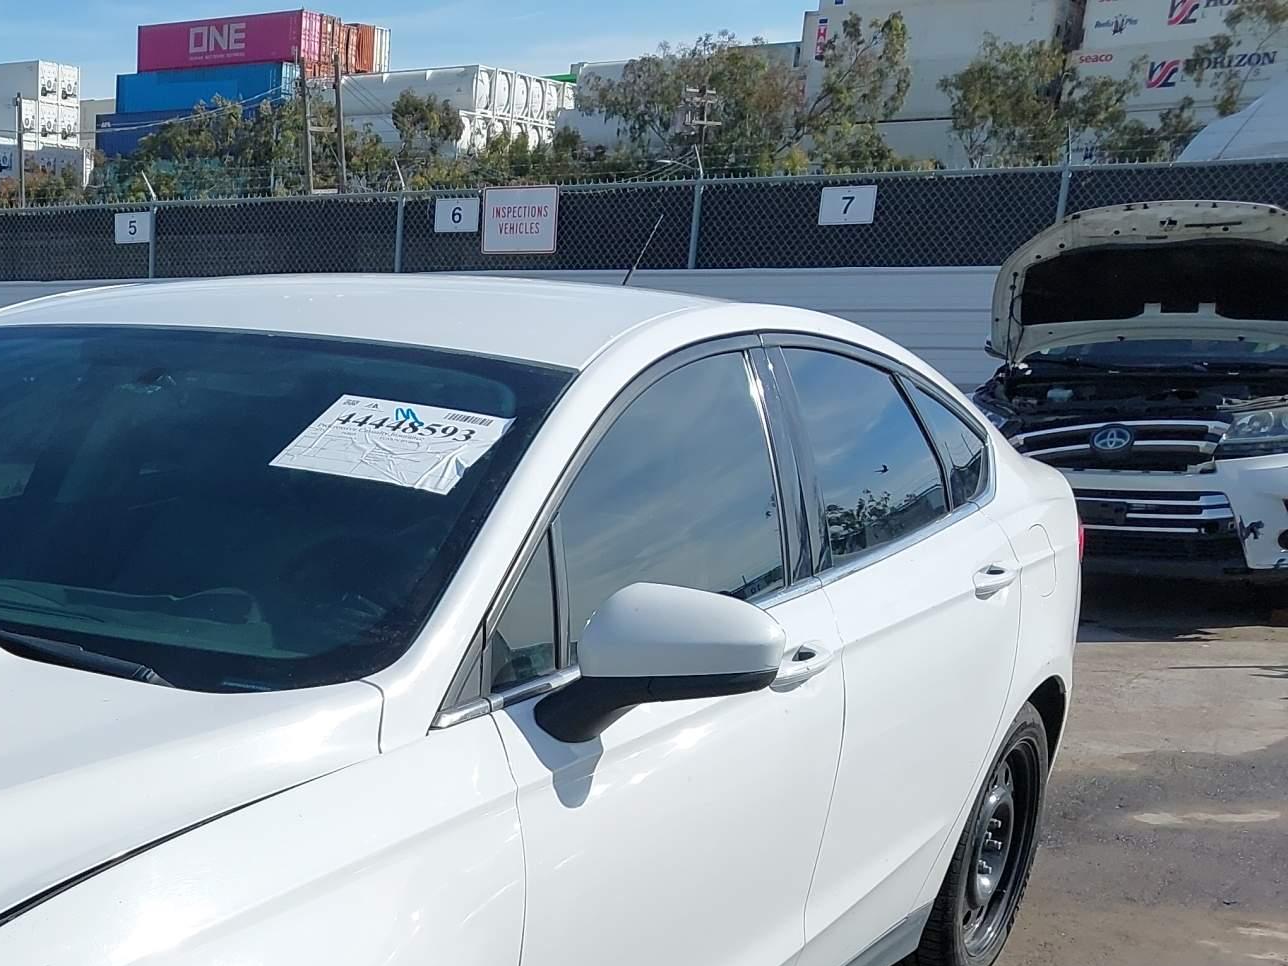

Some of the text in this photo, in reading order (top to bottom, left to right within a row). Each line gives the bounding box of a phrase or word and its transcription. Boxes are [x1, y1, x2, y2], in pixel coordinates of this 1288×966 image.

[189, 23, 246, 53] ONE
[1079, 53, 1113, 64] seaco
[492, 205, 549, 219] INSPECTIONS
[841, 196, 856, 215] 7
[451, 206, 463, 224] 6
[128, 220, 138, 236] 5
[498, 222, 540, 235] VEHICLES
[336, 412, 476, 442] 44448593
